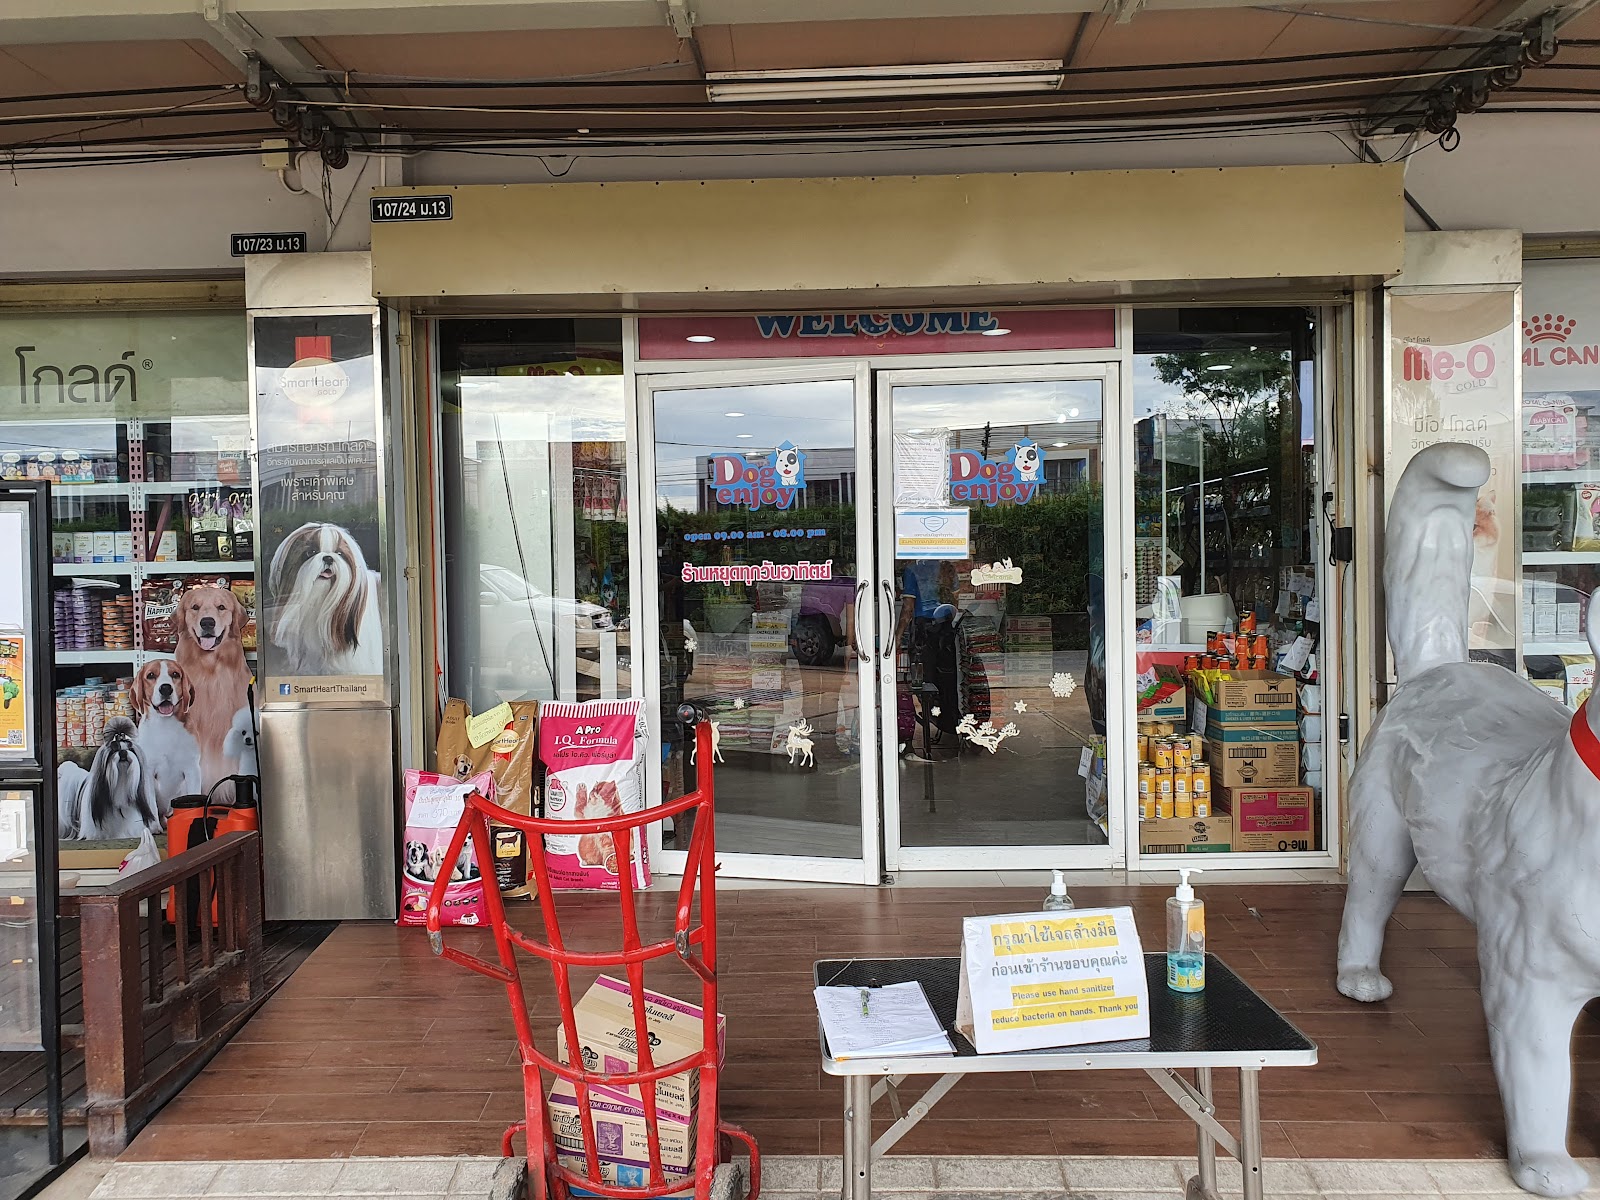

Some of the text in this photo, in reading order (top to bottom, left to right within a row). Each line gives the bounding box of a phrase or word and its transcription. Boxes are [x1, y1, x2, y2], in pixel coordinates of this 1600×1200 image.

[377, 201, 446, 217] 107/24 ม.13
[237, 238, 300, 252] 107/23 ม.13
[754, 311, 1000, 338] WELCOME
[280, 375, 350, 389] SmartHeart
[713, 456, 776, 487] Dog
[950, 453, 1015, 483] Dog
[291, 489, 345, 503] สำหรับคุณ
[717, 483, 795, 509] enjoy
[953, 479, 1035, 504] enjoy
[684, 532, 712, 542] open
[714, 531, 744, 541] 09.00
[807, 529, 826, 538] pm
[681, 559, 833, 586] ร้านหยุดทุกวันอาทิตย์
[294, 684, 367, 695] SmartHeartThailand
[579, 736, 618, 745] Formula
[993, 920, 1117, 950] กรุณาใช้เจลล้างมือ
[991, 951, 1128, 978] ก่อนเข้าร้านขอบคุณค่ะ
[1012, 992, 1040, 1000] Please
[1059, 987, 1079, 996] hand
[1081, 984, 1115, 994] sanitizer
[992, 1002, 1139, 1025] reduce bacteria on hands. Thank you
